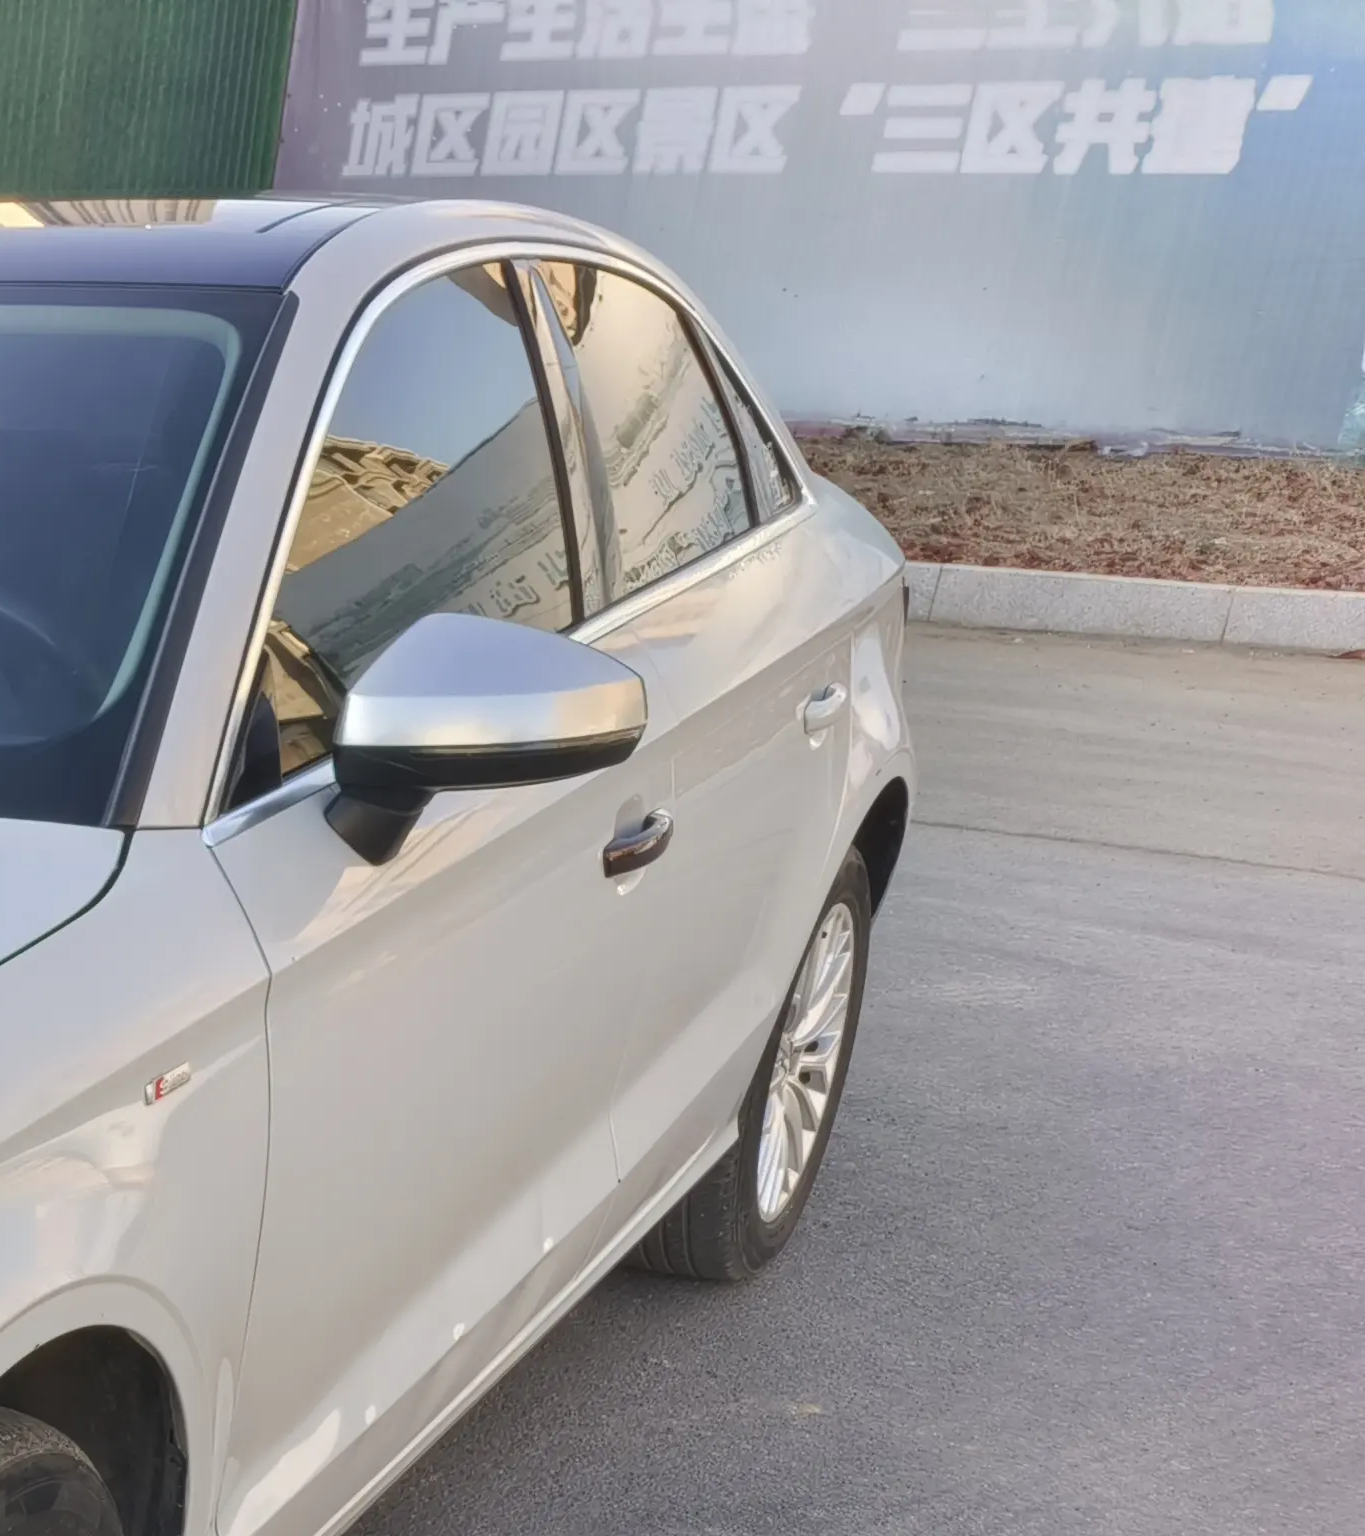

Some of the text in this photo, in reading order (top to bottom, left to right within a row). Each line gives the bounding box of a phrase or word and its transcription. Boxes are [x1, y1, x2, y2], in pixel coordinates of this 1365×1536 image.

[341, 84, 802, 177] 城区园区景区
